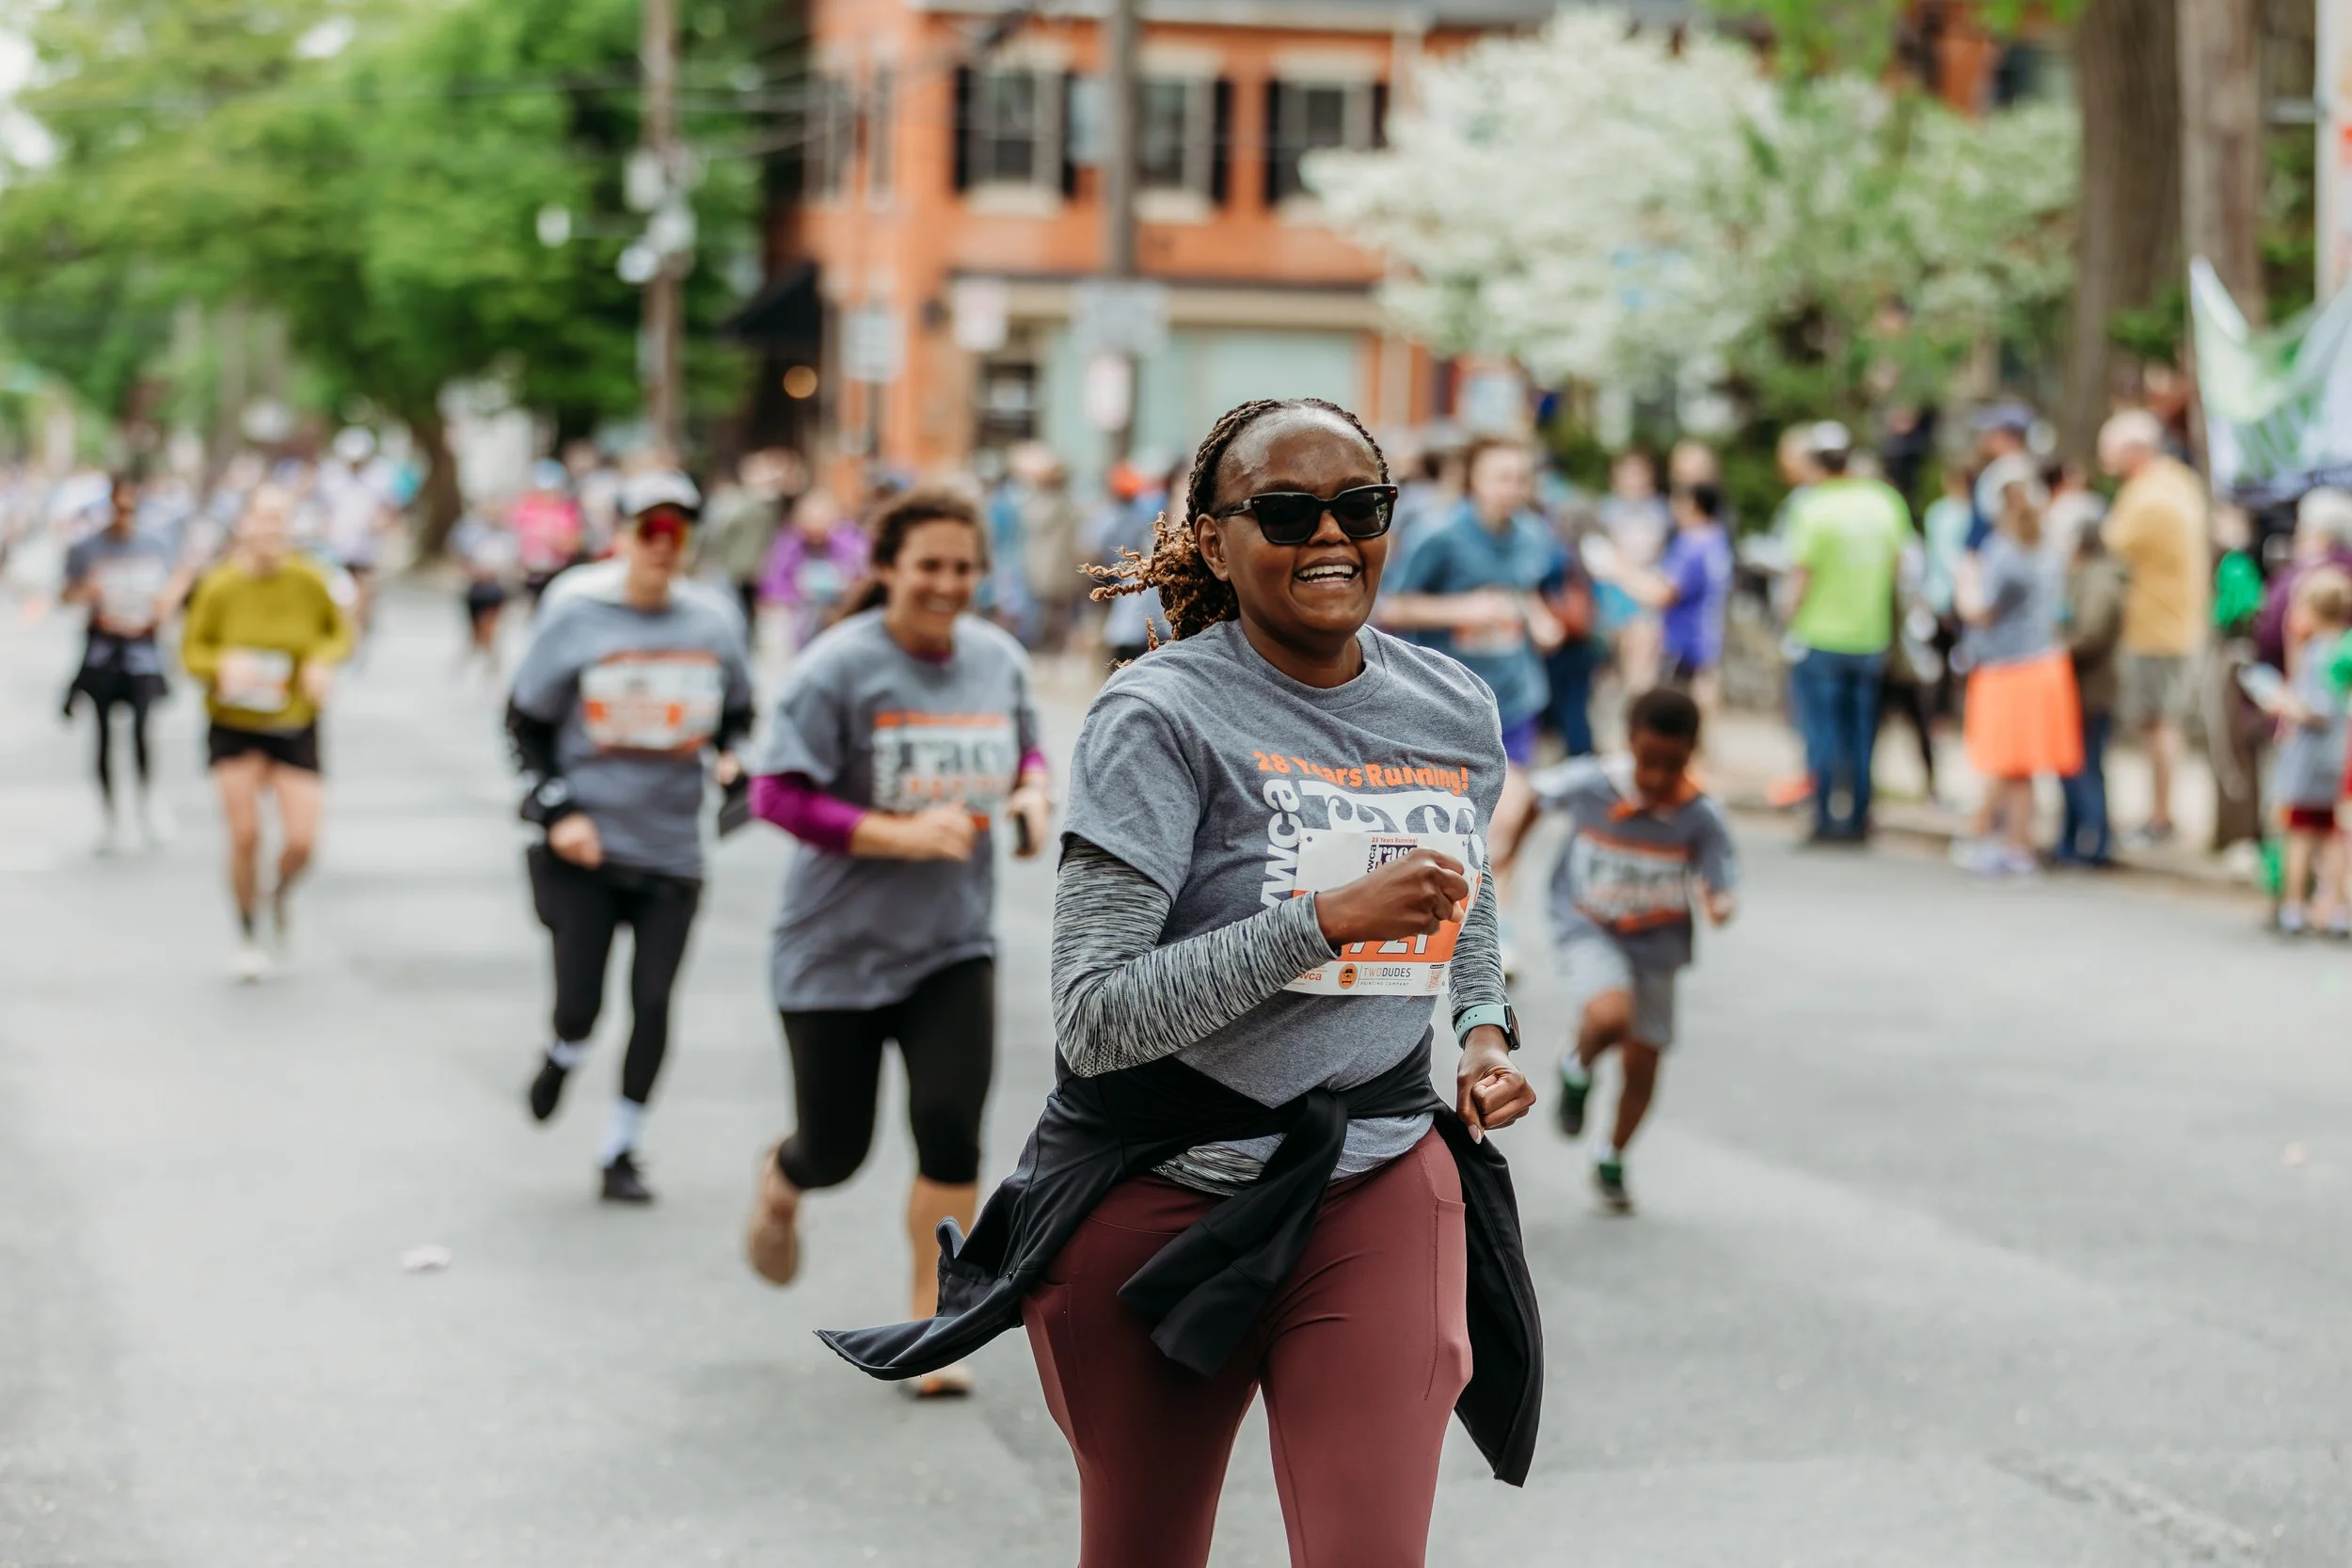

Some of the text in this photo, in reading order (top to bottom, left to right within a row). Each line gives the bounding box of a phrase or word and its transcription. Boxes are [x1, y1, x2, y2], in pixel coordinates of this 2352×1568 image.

[1253, 751, 1470, 797] 28 Years Running!
[1261, 779, 1304, 909] wca
[1366, 844, 1376, 873] wca
[1376, 845, 1418, 863] rac
[1298, 972, 1322, 981] wca
